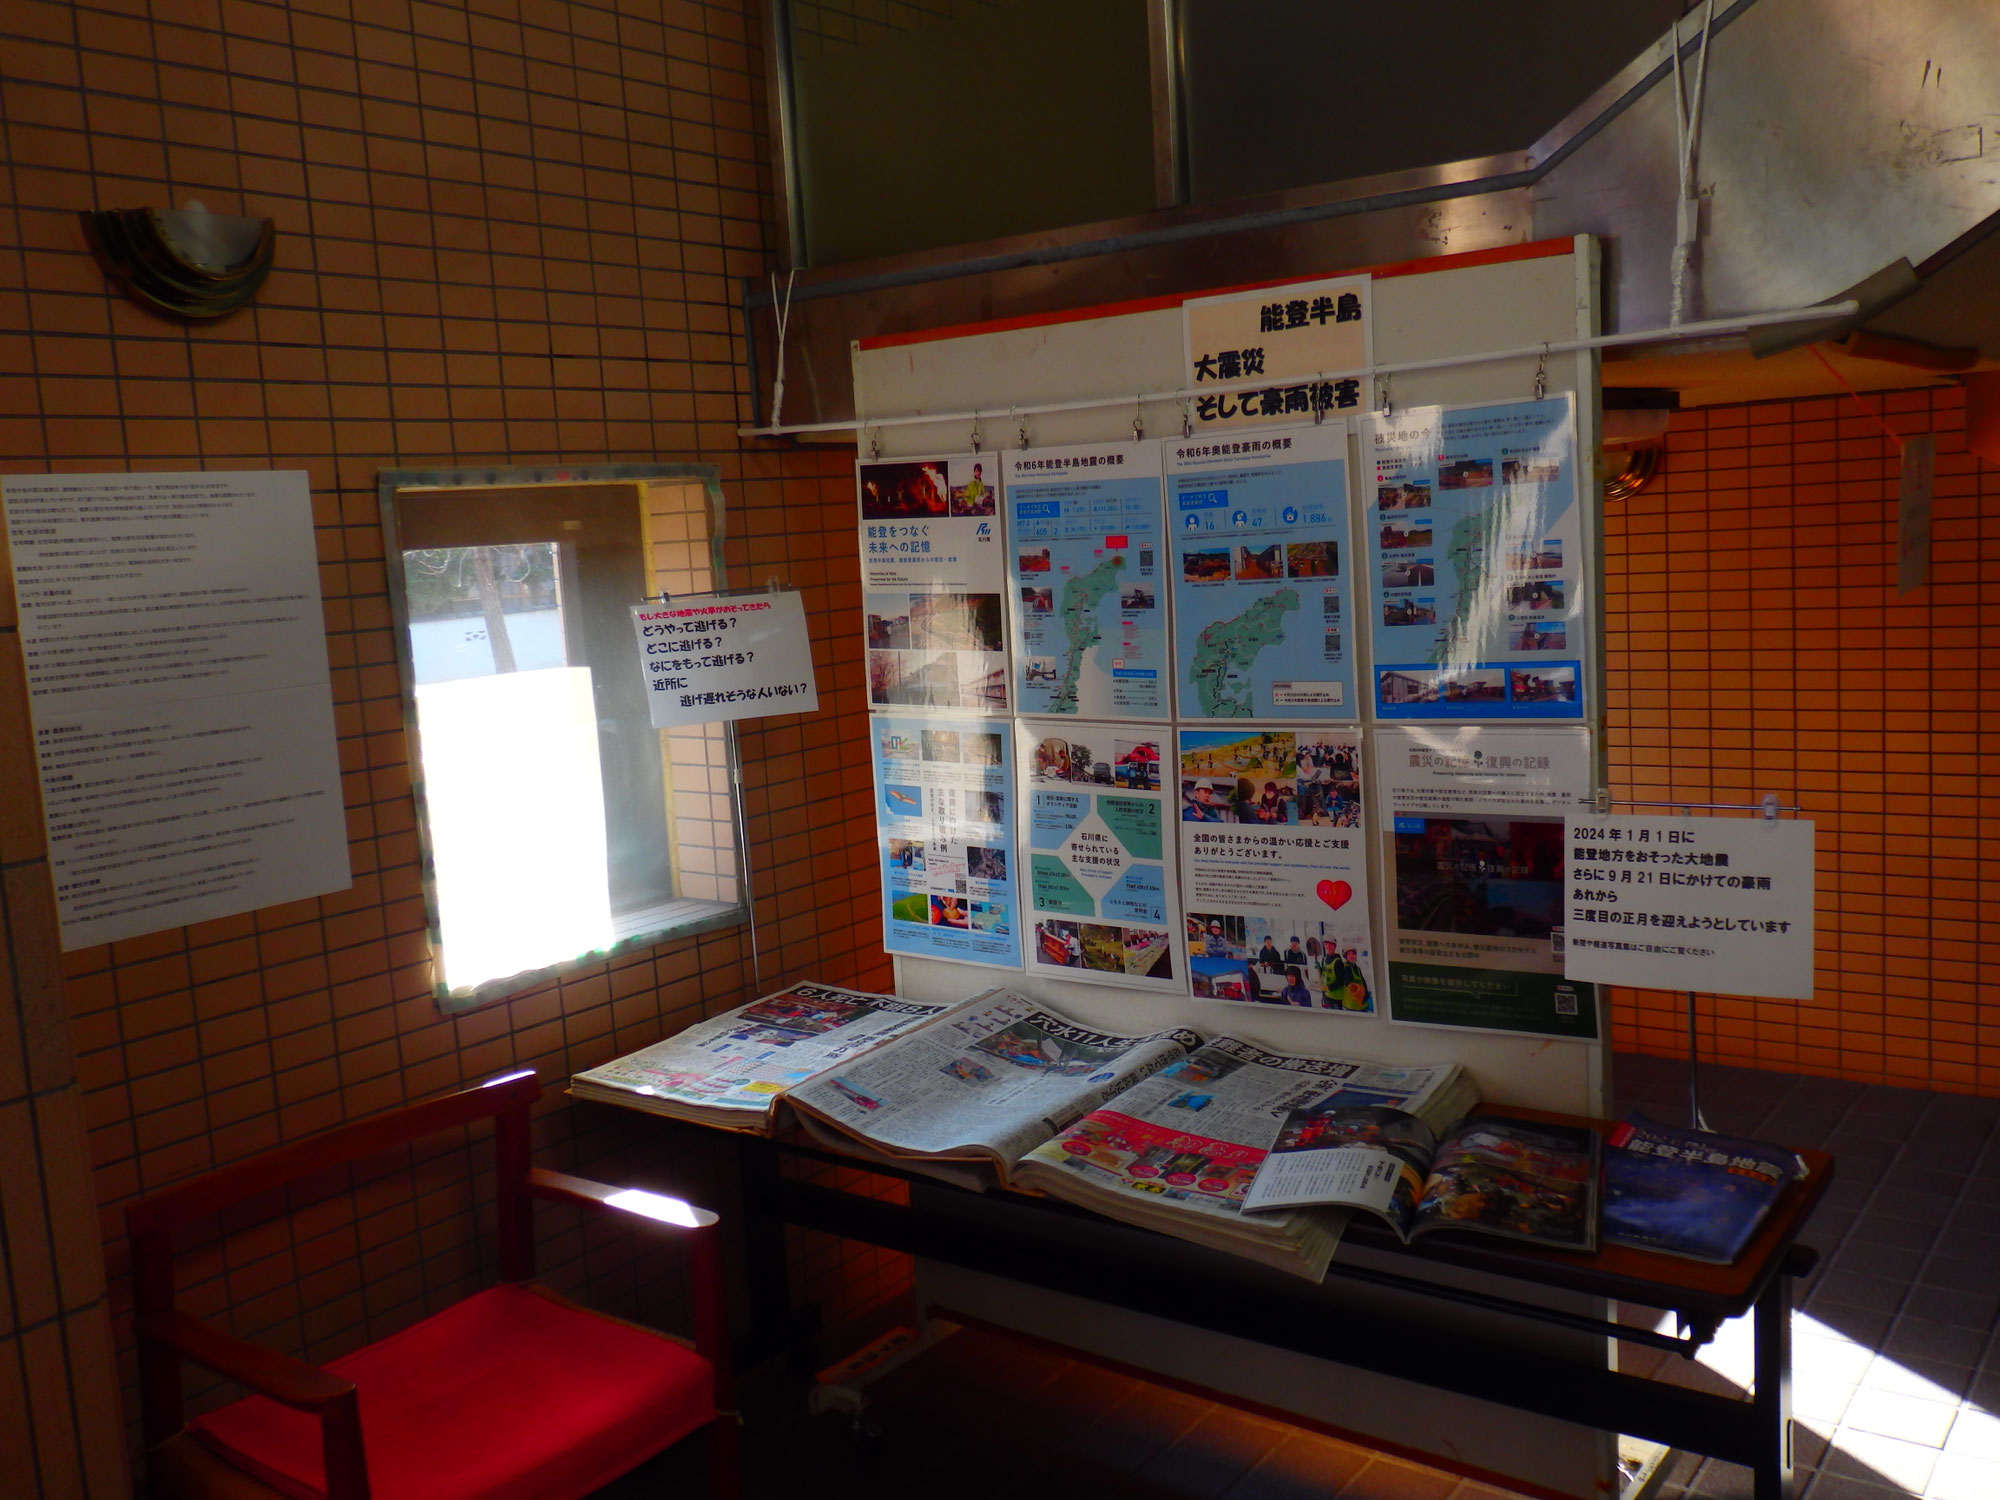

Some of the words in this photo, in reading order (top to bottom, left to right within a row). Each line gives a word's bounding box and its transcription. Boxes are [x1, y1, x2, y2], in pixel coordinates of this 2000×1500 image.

[1260, 293, 1361, 332] 能登半島
[1194, 347, 1265, 382] 大震災
[1196, 380, 1360, 421] そして豪雨被害
[1176, 438, 1292, 459] 令和6年奥能登豪雨の概要
[1014, 454, 1124, 471] 令和6年能登半島地震の概要
[868, 525, 929, 538] 能登をつなぐ
[868, 541, 931, 554] 未来への記憶
[639, 602, 771, 621] もし大きな地震や火事がおそってきたら
[643, 618, 737, 637] どうやって逃げる？
[646, 637, 722, 655] どこに逃げる？
[650, 652, 754, 673] なにをもって逃げる？
[652, 677, 688, 691] 近所に
[680, 683, 807, 708] 逃げ遅れそうな人いない？
[1486, 756, 1551, 770] 復興の記録
[1081, 833, 1108, 842] 石川県に
[1193, 833, 1350, 849] 全国の皆さまからの温かい応援とご支援
[1071, 843, 1119, 855] 寄せられている
[1193, 846, 1282, 860] ありがとうございます。
[1573, 847, 1729, 867] 能登地方をおそった大地震
[1071, 854, 1120, 867] 主な支援の状況
[1573, 868, 1771, 891] さらに9月21日にかけての豪雨
[1040, 897, 1045, 907] 3
[1572, 889, 1618, 903] あれから
[1154, 910, 1160, 920] 4
[1572, 908, 1791, 934] 三度目の正月を迎えようとしています
[1627, 1138, 1784, 1180] 能登半島地震
